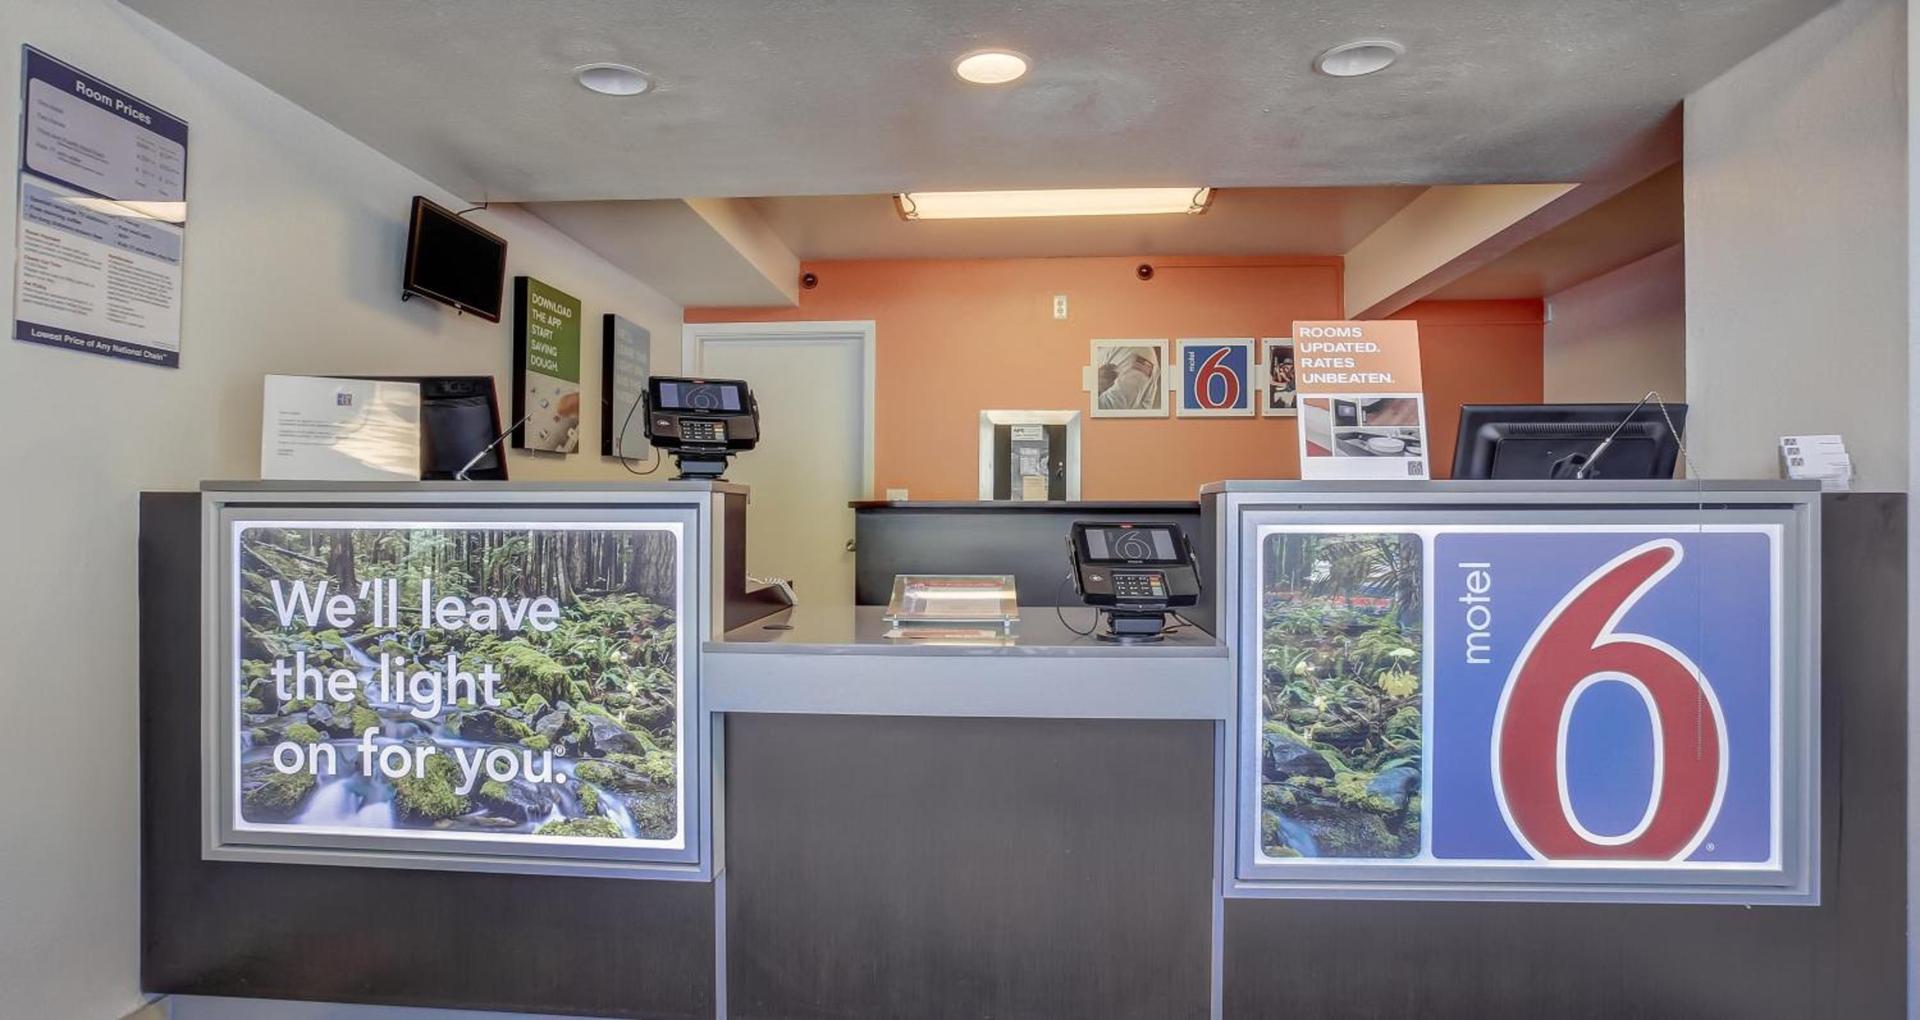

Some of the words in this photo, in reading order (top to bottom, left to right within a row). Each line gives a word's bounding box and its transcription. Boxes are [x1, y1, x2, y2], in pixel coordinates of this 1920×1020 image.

[75, 80, 113, 107] Room
[115, 99, 152, 125] Prices
[531, 293, 572, 318] DOWNLOAD
[532, 309, 546, 323] THE
[31, 328, 62, 342] Lowest
[63, 333, 85, 346] Price
[86, 338, 95, 347] of
[96, 340, 111, 353] Any
[112, 344, 142, 357] National
[531, 324, 553, 340] START
[1299, 327, 1362, 338] ROOMS
[530, 339, 557, 357] SAVING
[1300, 342, 1381, 353] UPDATED.
[1301, 357, 1355, 368] RATES
[1194, 346, 1240, 409] 6
[1302, 372, 1396, 384] UNBEATEN.
[1115, 530, 1152, 560] 6
[270, 578, 398, 629] We'll
[421, 578, 560, 632] leave
[1458, 561, 1492, 665] motel
[271, 651, 358, 702] the
[381, 652, 502, 720] light
[1490, 537, 1729, 861] 6
[272, 740, 337, 776] on
[358, 727, 436, 780] for
